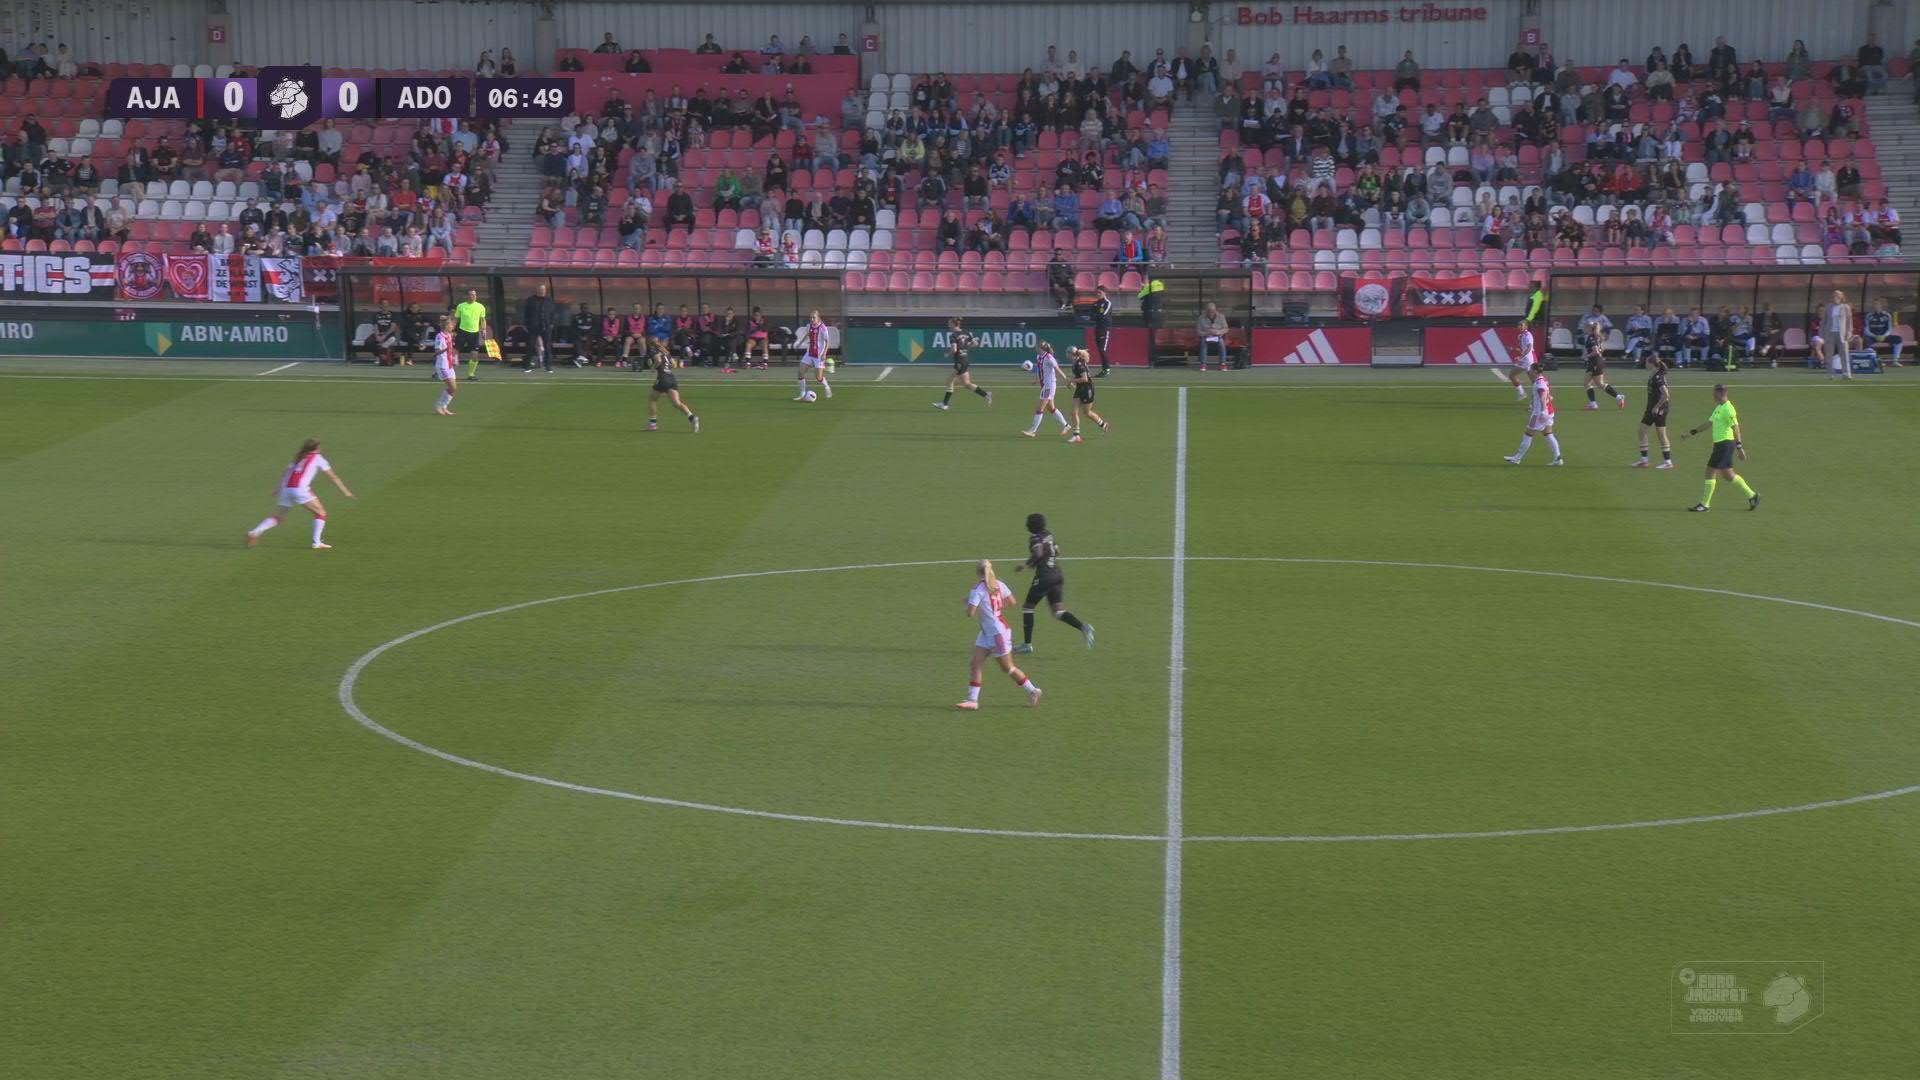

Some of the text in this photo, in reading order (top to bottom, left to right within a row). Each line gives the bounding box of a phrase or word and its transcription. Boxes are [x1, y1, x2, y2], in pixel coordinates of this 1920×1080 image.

[1237, 3, 1487, 26] Bob Haarms tribune
[0, 254, 91, 294] TICS
